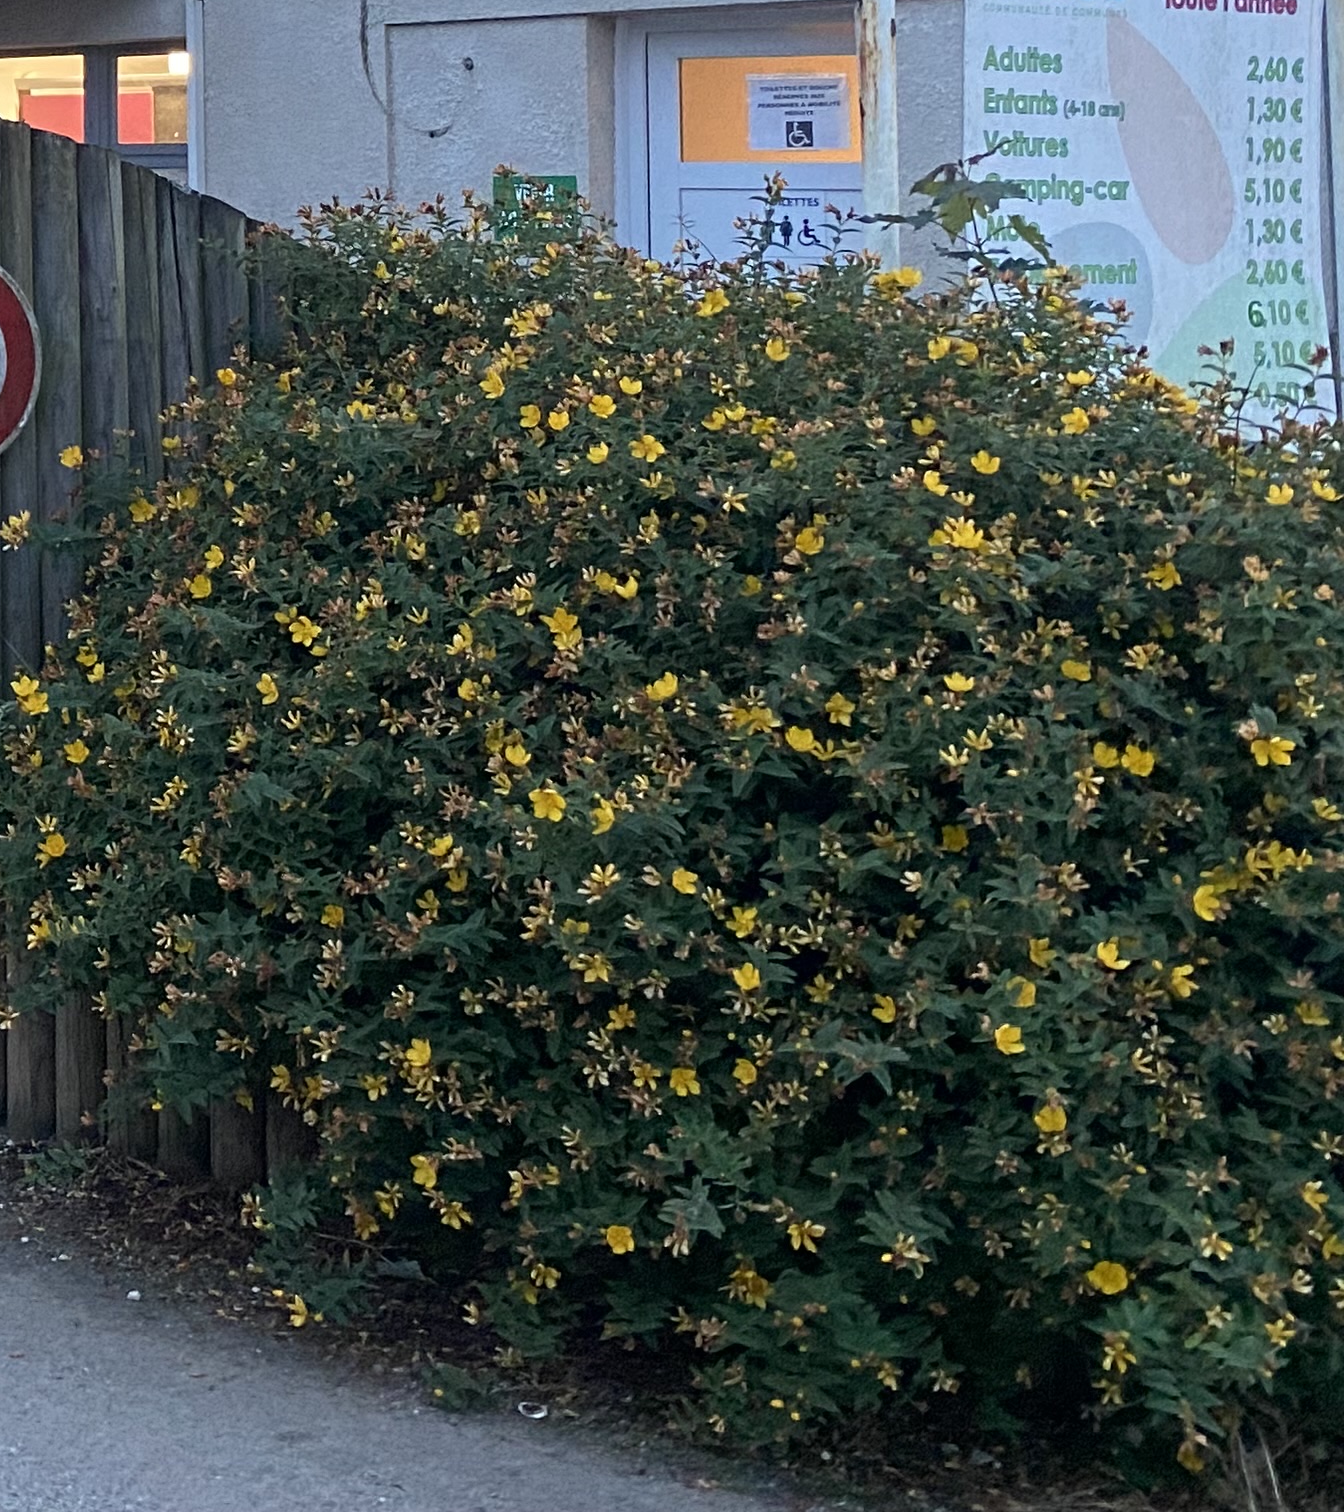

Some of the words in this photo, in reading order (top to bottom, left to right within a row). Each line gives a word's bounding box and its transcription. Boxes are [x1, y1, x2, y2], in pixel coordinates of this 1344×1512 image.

[982, 44, 1063, 74] Adultes
[1246, 55, 1288, 84] 2,60
[1292, 57, 1304, 83] €
[983, 87, 1058, 115] Enfants
[1063, 99, 1095, 119] (4-18
[1098, 101, 1125, 121] ans)
[1246, 96, 1286, 125] 1,30
[1290, 98, 1303, 124] €
[983, 129, 1069, 158] Voitures
[1245, 137, 1286, 163] 1,90
[1289, 137, 1303, 163] €
[1244, 177, 1286, 205] 5,10
[1289, 178, 1303, 204] €
[1245, 218, 1286, 246] 1,30
[1289, 218, 1303, 245] €
[1246, 258, 1288, 287] 2,60
[1291, 258, 1305, 286] €
[1248, 299, 1291, 328] 6,10
[1295, 299, 1310, 326] €
[1254, 340, 1295, 369] 5,10
